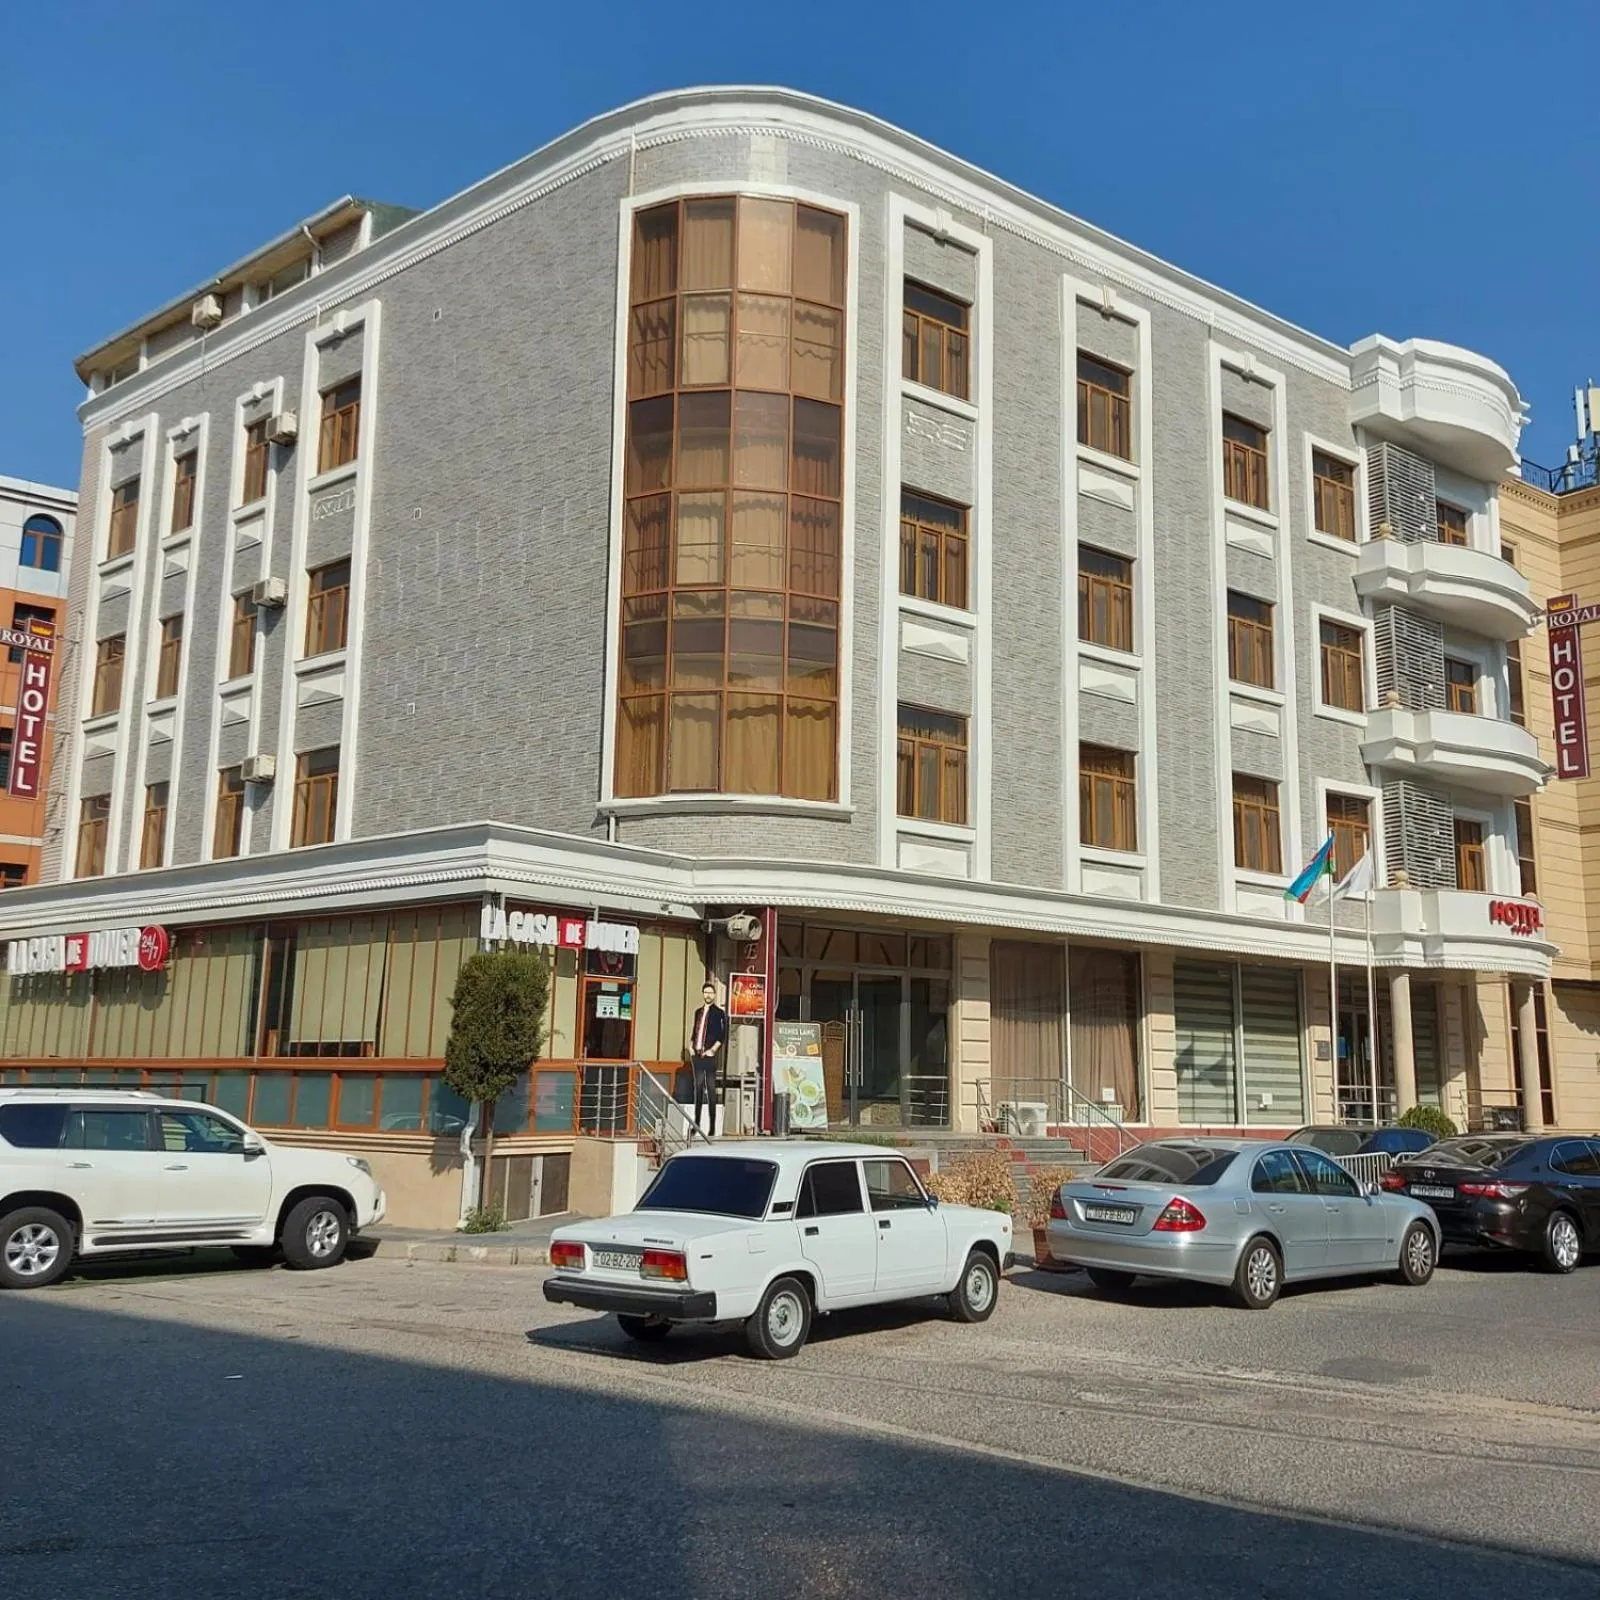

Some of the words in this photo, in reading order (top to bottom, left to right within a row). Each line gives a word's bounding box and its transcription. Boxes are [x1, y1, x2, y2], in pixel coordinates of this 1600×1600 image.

[1550, 606, 1600, 629] ROYAL
[2, 630, 50, 651] ROYAL
[1553, 640, 1580, 773] HOTEL
[16, 663, 46, 790] HOTEL
[480, 904, 507, 941] LA
[509, 911, 559, 946] CASA
[566, 922, 584, 945] DE
[1489, 900, 1543, 928] HOTEL
